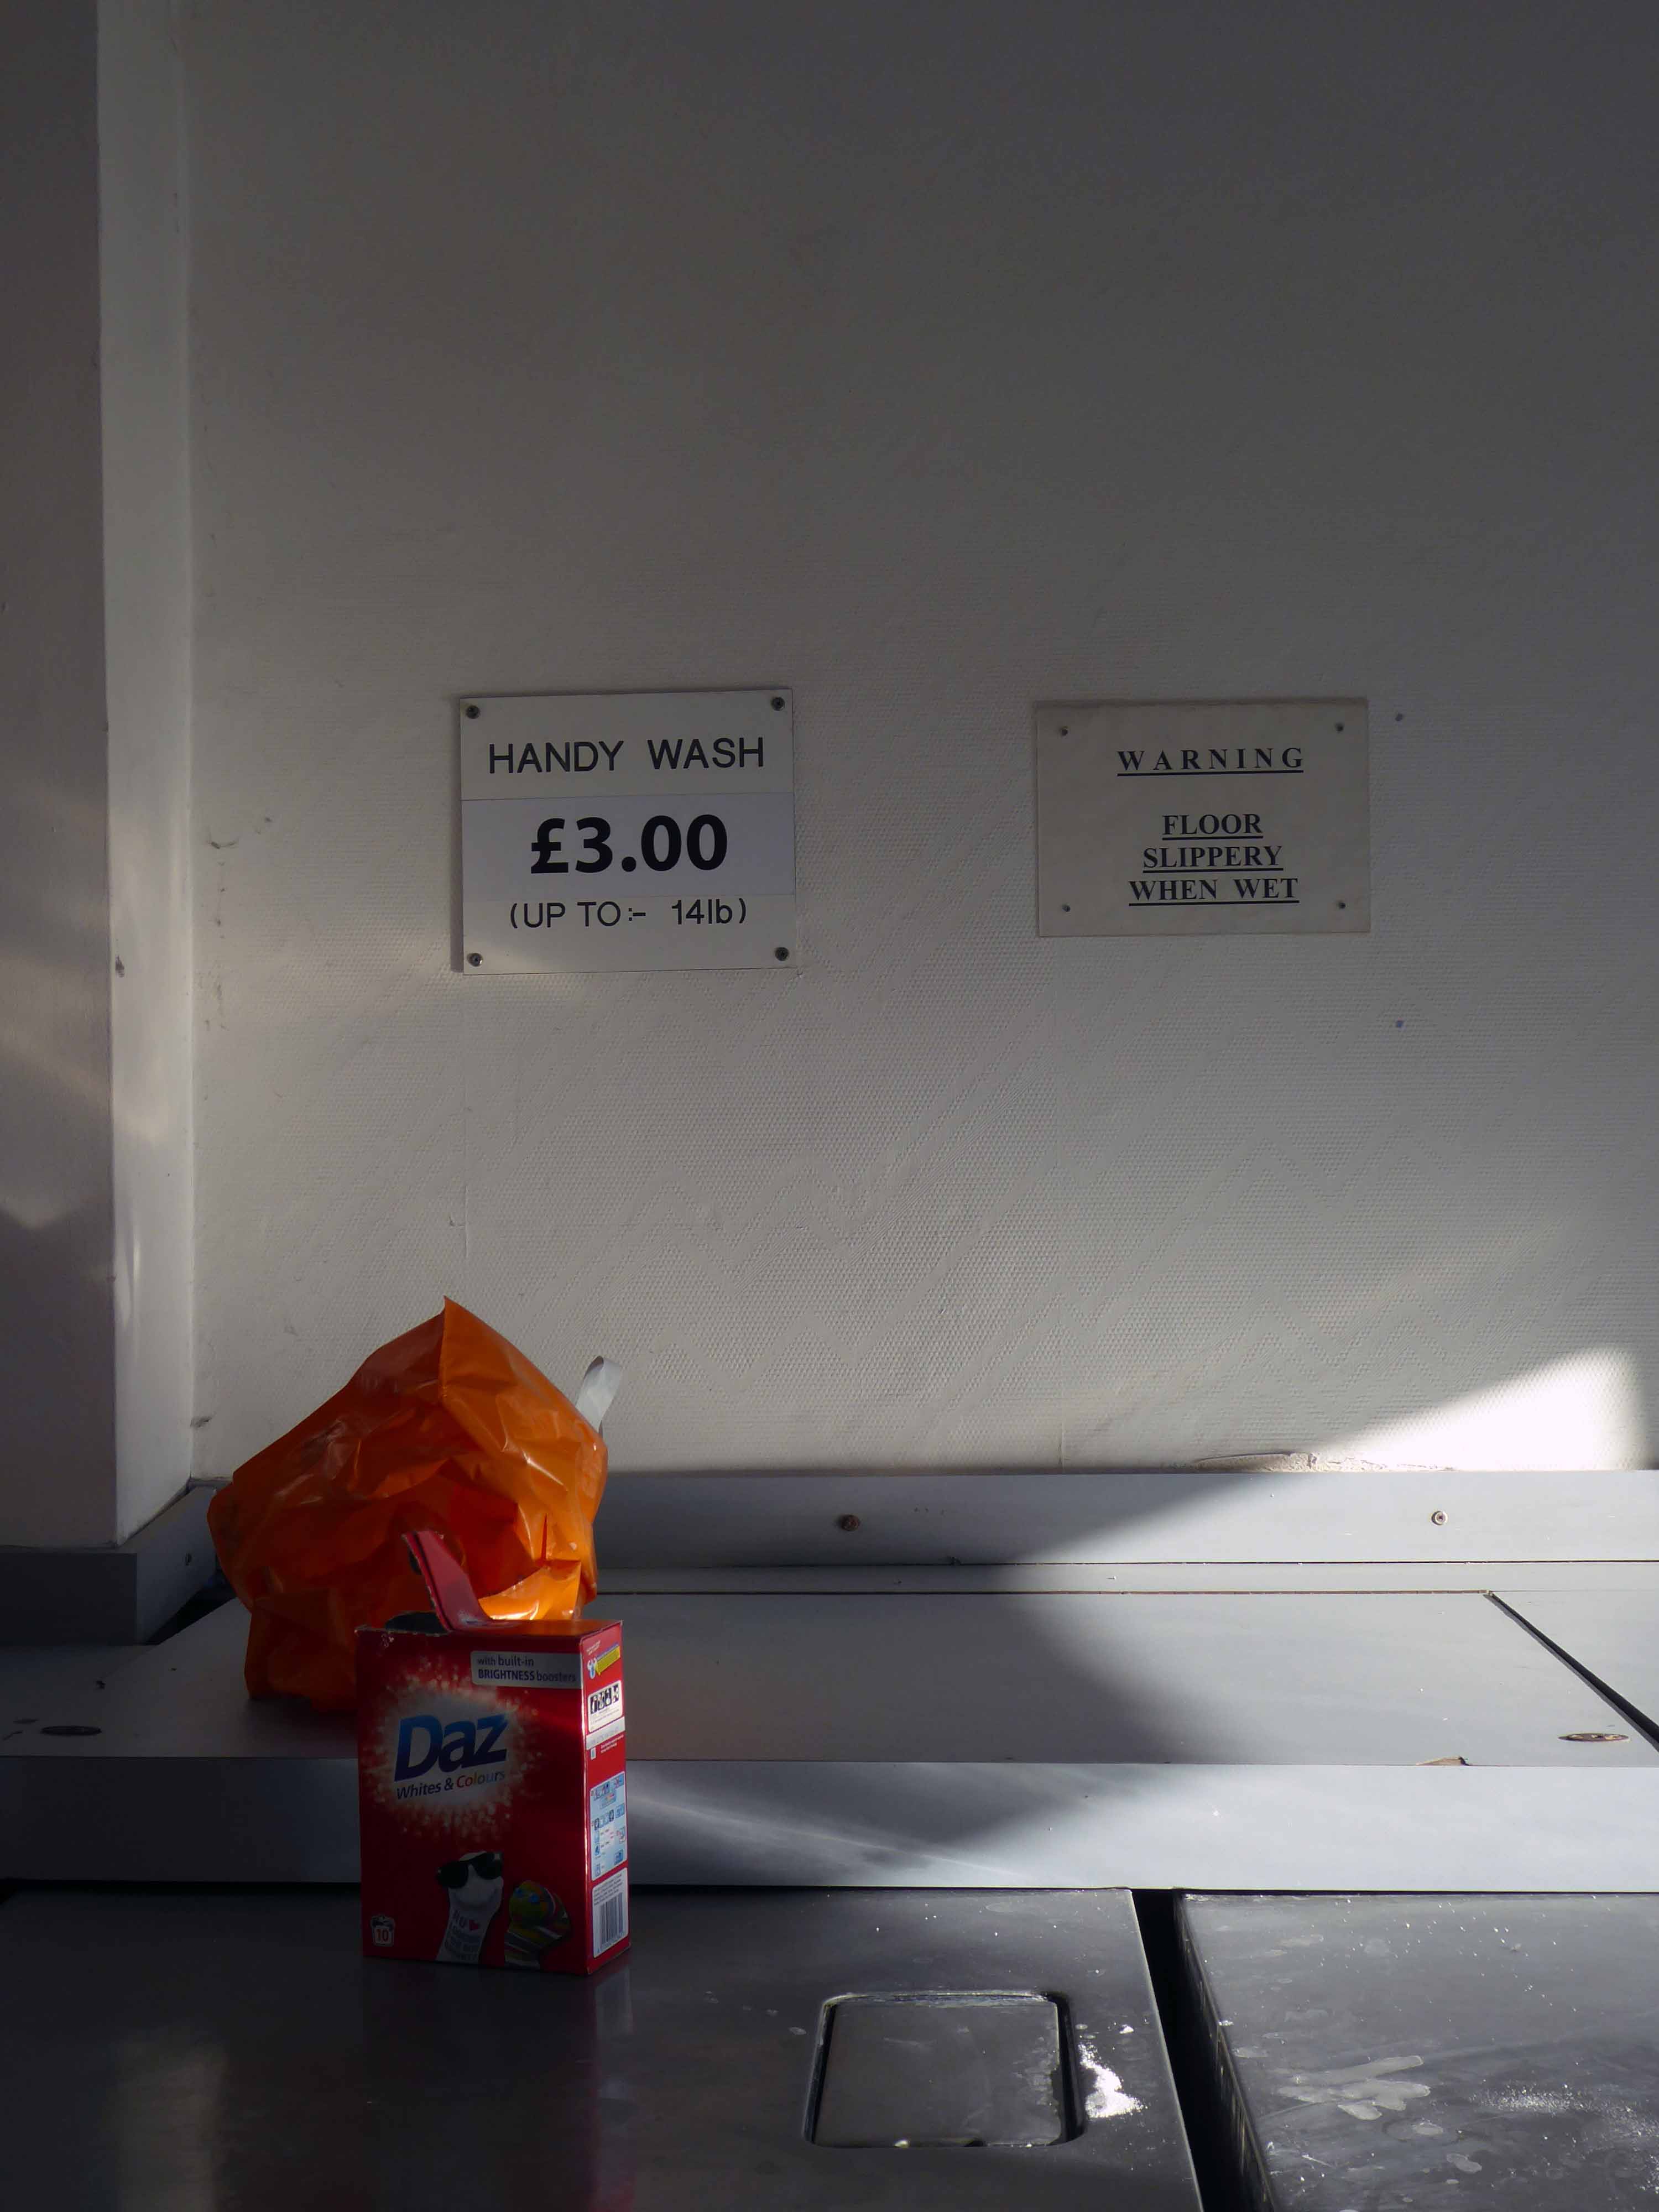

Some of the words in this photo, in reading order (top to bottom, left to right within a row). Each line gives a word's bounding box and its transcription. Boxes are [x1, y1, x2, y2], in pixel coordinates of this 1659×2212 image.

[489, 740, 624, 774] HANDY
[647, 737, 764, 770] WASH
[1117, 747, 1304, 771] WARNING
[1162, 813, 1263, 836] FLOOR
[530, 813, 728, 874] £3.00
[1142, 845, 1283, 869] SLIPPERY
[1128, 879, 1218, 901] WHEN
[1233, 878, 1298, 899] WET
[510, 902, 566, 928] (UP
[671, 898, 747, 925] 14lb)
[477, 1656, 495, 1666] with
[498, 1655, 534, 1667] built-in
[478, 1668, 535, 1682] BRIGHTNESS
[536, 1671, 576, 1682] boosters
[394, 1713, 508, 1782] Daz
[397, 1782, 442, 1799] Whites
[444, 1777, 454, 1791] &
[456, 1770, 505, 1788] Colours
[375, 1928, 389, 1942] 10
